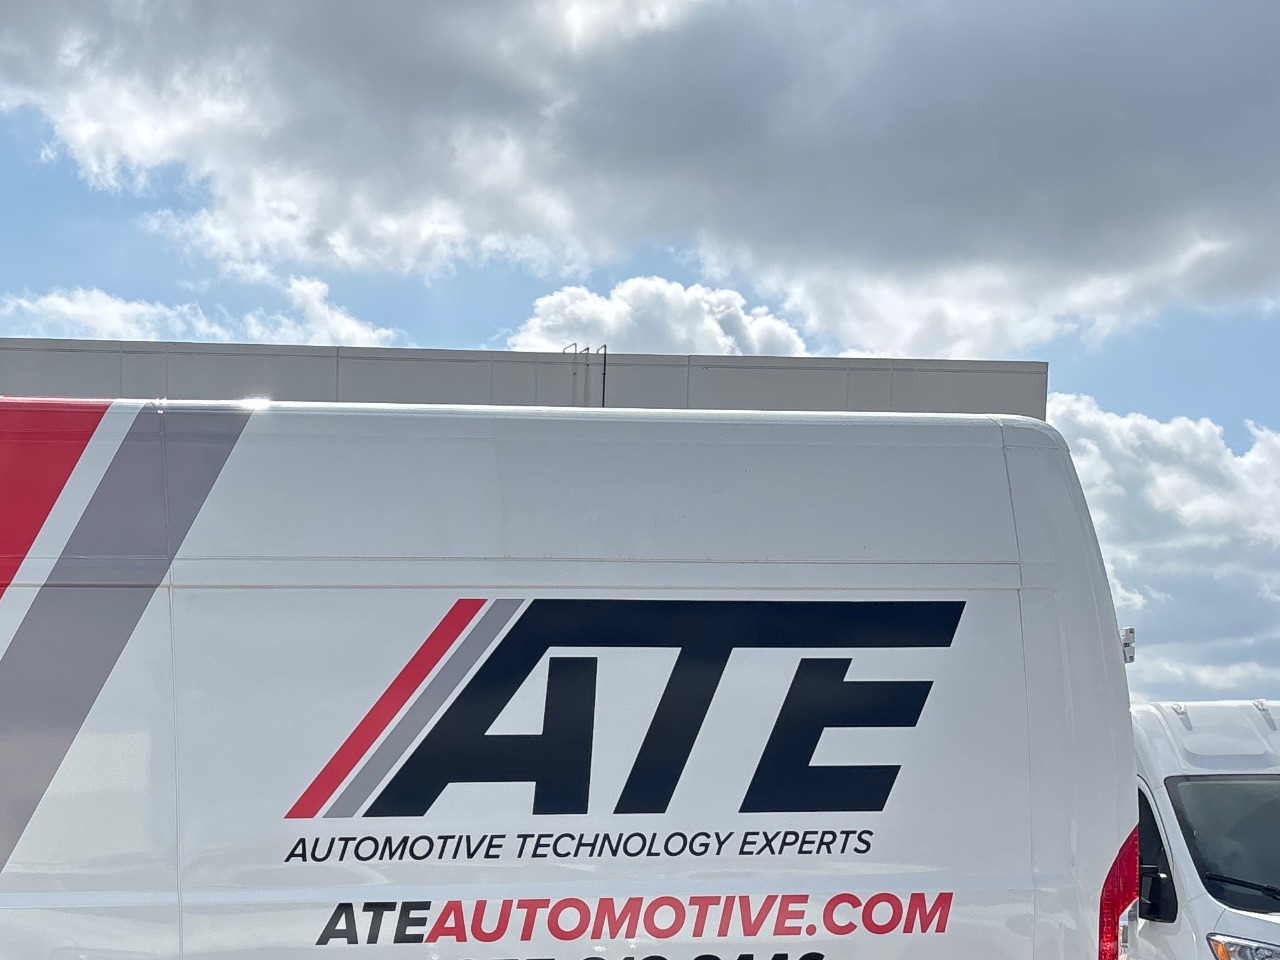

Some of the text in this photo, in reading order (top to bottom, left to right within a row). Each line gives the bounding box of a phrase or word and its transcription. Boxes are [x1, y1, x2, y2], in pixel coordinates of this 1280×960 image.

[362, 599, 966, 817] ATE
[284, 829, 874, 863] AUTOMOTIVE TECHNOLOGY EXPERTS
[315, 892, 954, 946] ATEAUTOMOTIVE.COM
